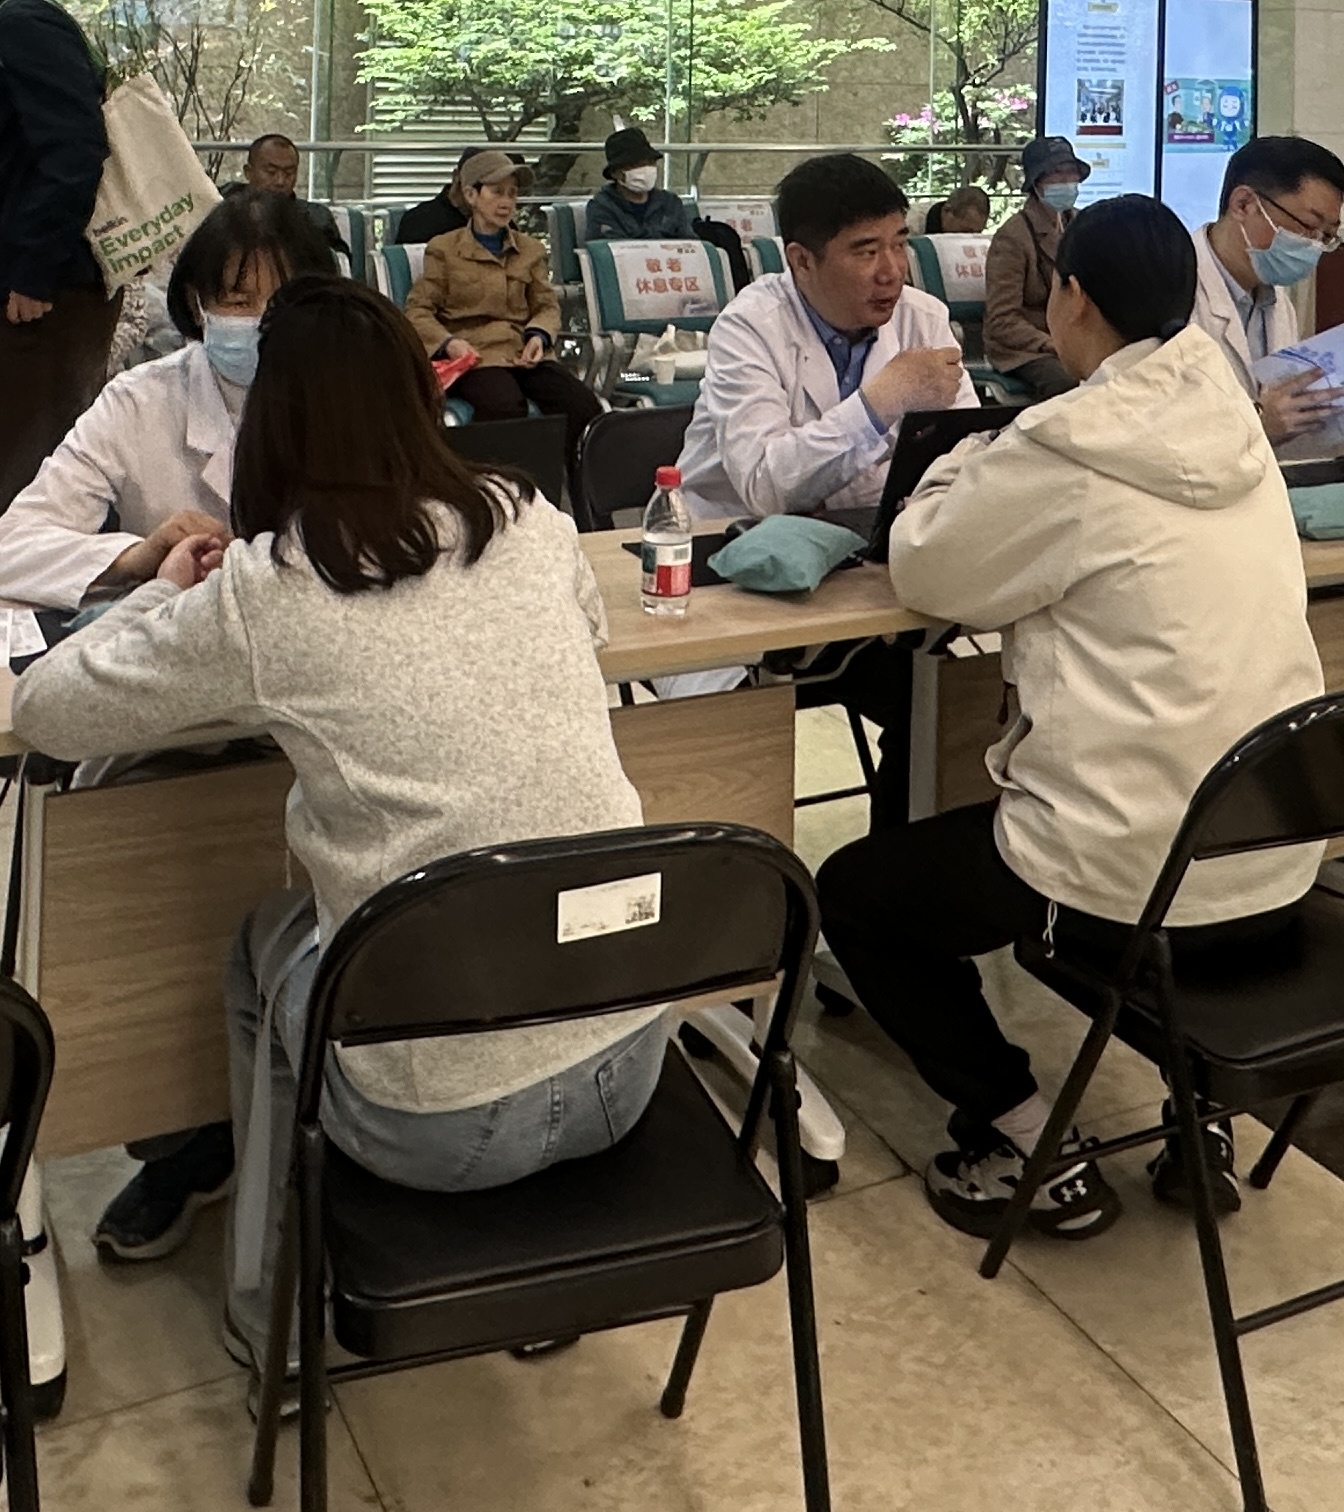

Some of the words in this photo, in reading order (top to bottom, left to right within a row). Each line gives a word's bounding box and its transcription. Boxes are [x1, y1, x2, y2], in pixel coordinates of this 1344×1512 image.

[99, 192, 194, 257] Everyday
[107, 224, 186, 273] Impact
[635, 275, 701, 295] 休息专区
